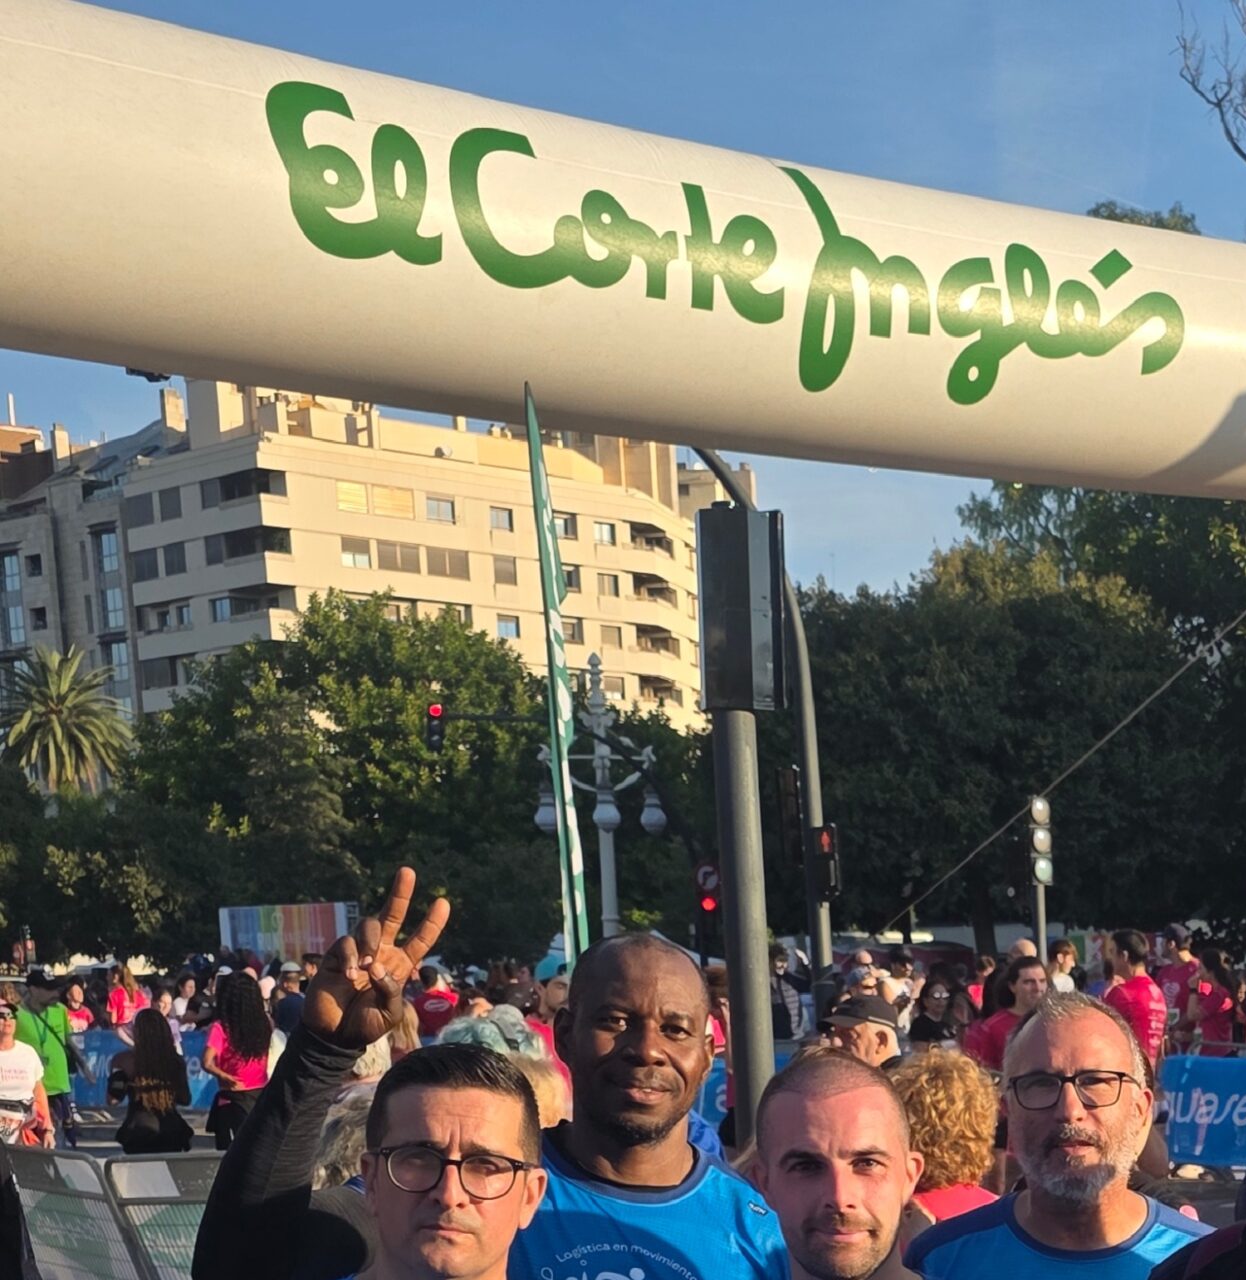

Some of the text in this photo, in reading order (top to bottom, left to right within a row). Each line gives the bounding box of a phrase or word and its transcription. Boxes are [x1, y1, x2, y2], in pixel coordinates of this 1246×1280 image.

[265, 81, 1184, 405] El Corte Inglés
[555, 1242, 610, 1263] Logística
[613, 1243, 628, 1252] en
